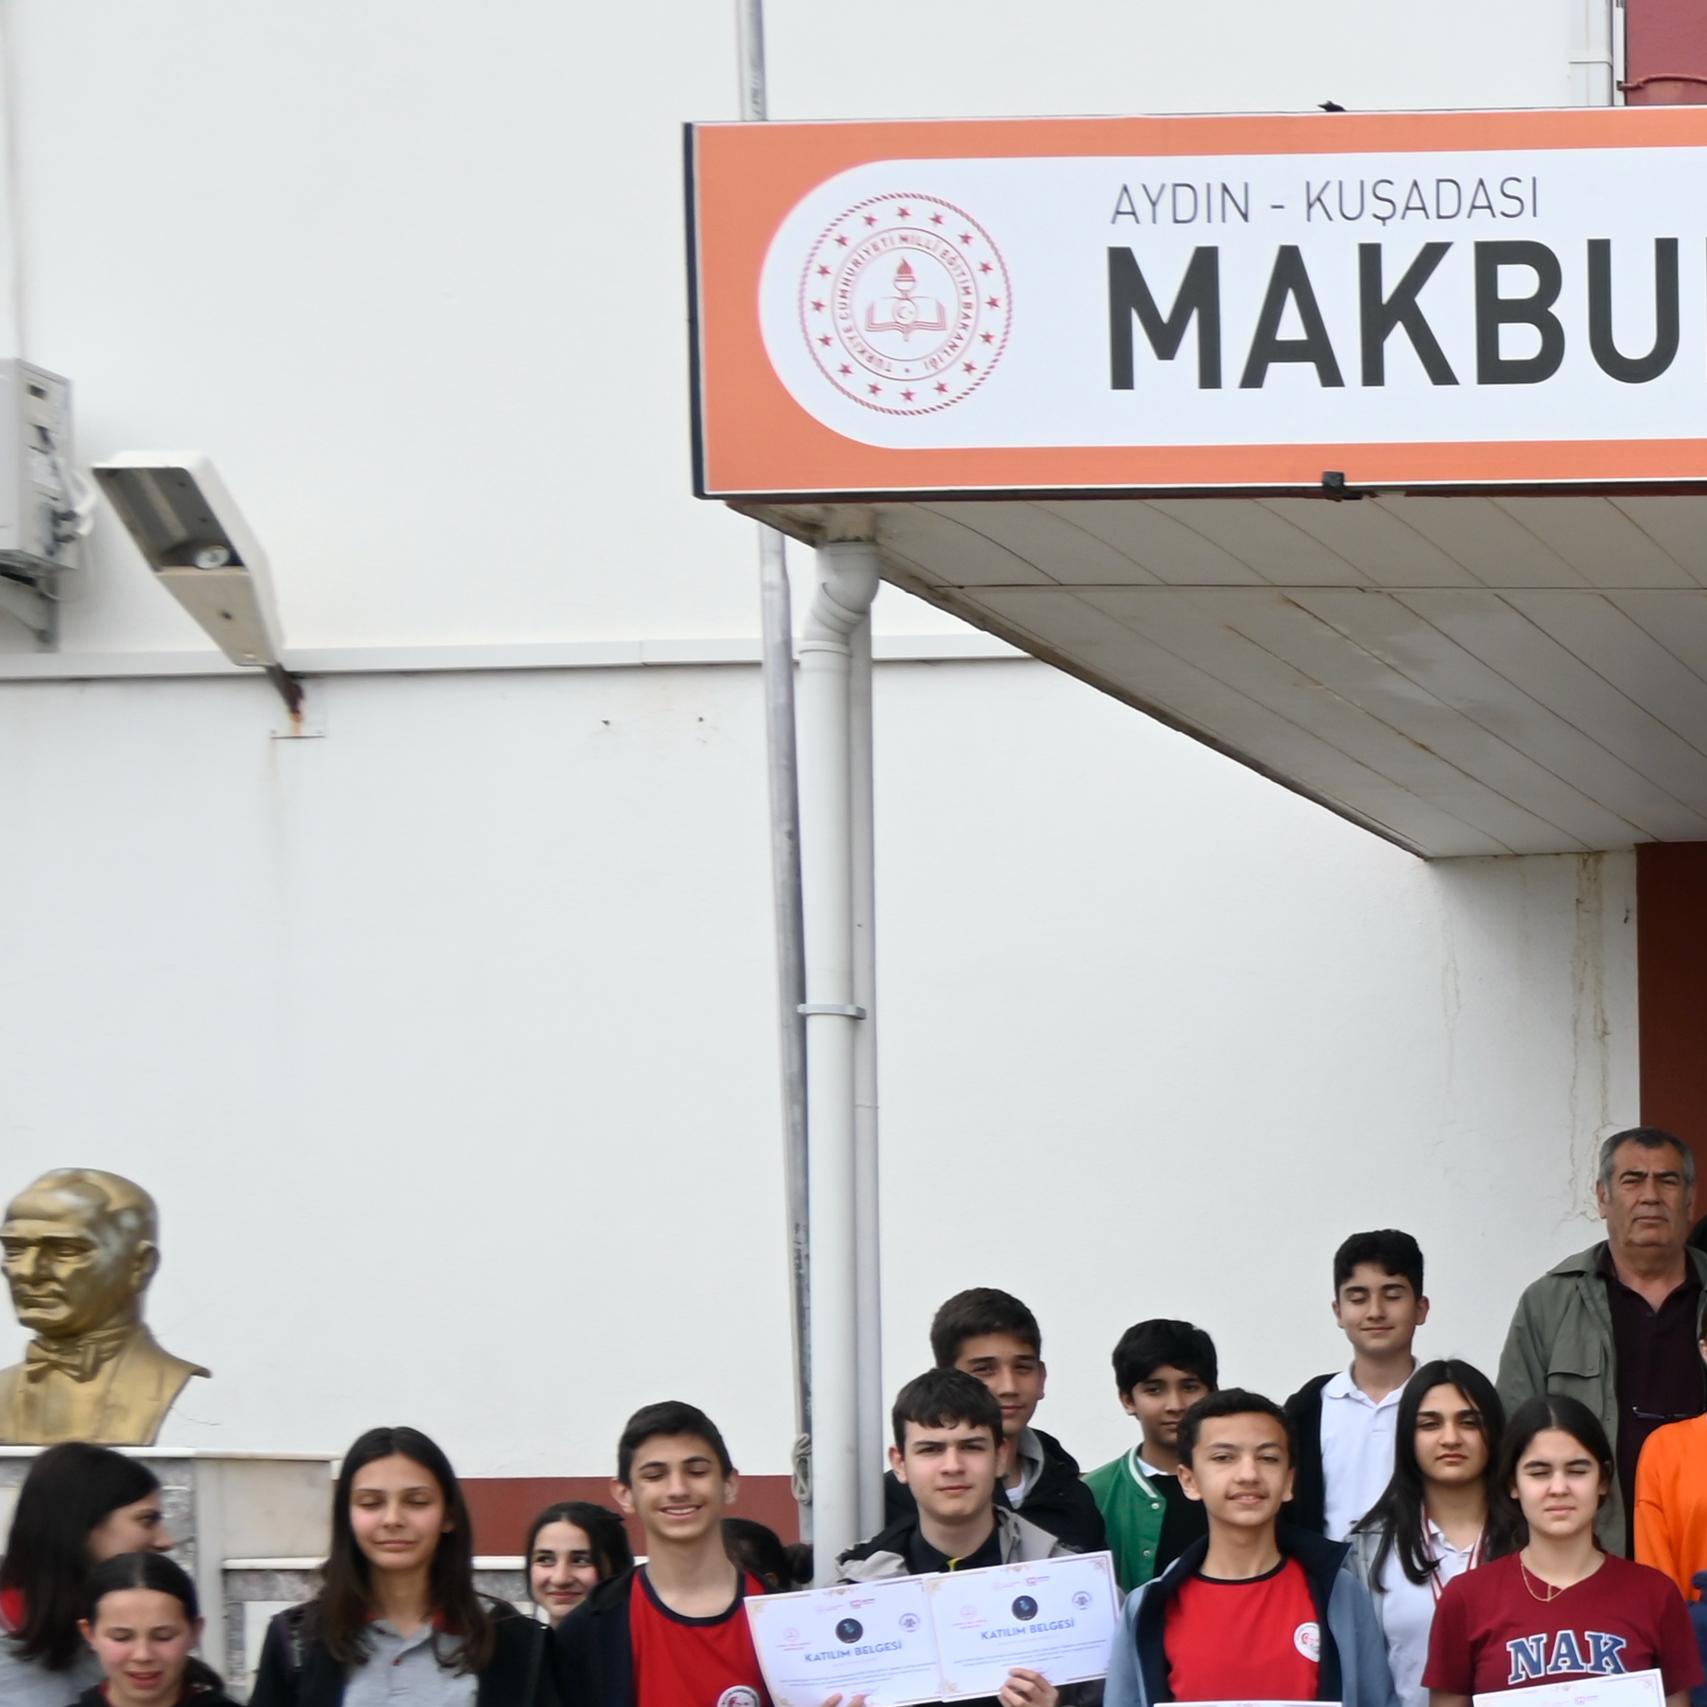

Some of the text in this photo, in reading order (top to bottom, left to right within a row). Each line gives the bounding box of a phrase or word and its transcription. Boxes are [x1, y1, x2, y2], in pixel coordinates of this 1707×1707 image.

[1111, 182, 1250, 225] AYDIN
[1305, 176, 1538, 227] KUŞADASI
[1506, 1629, 1627, 1685] NAK
